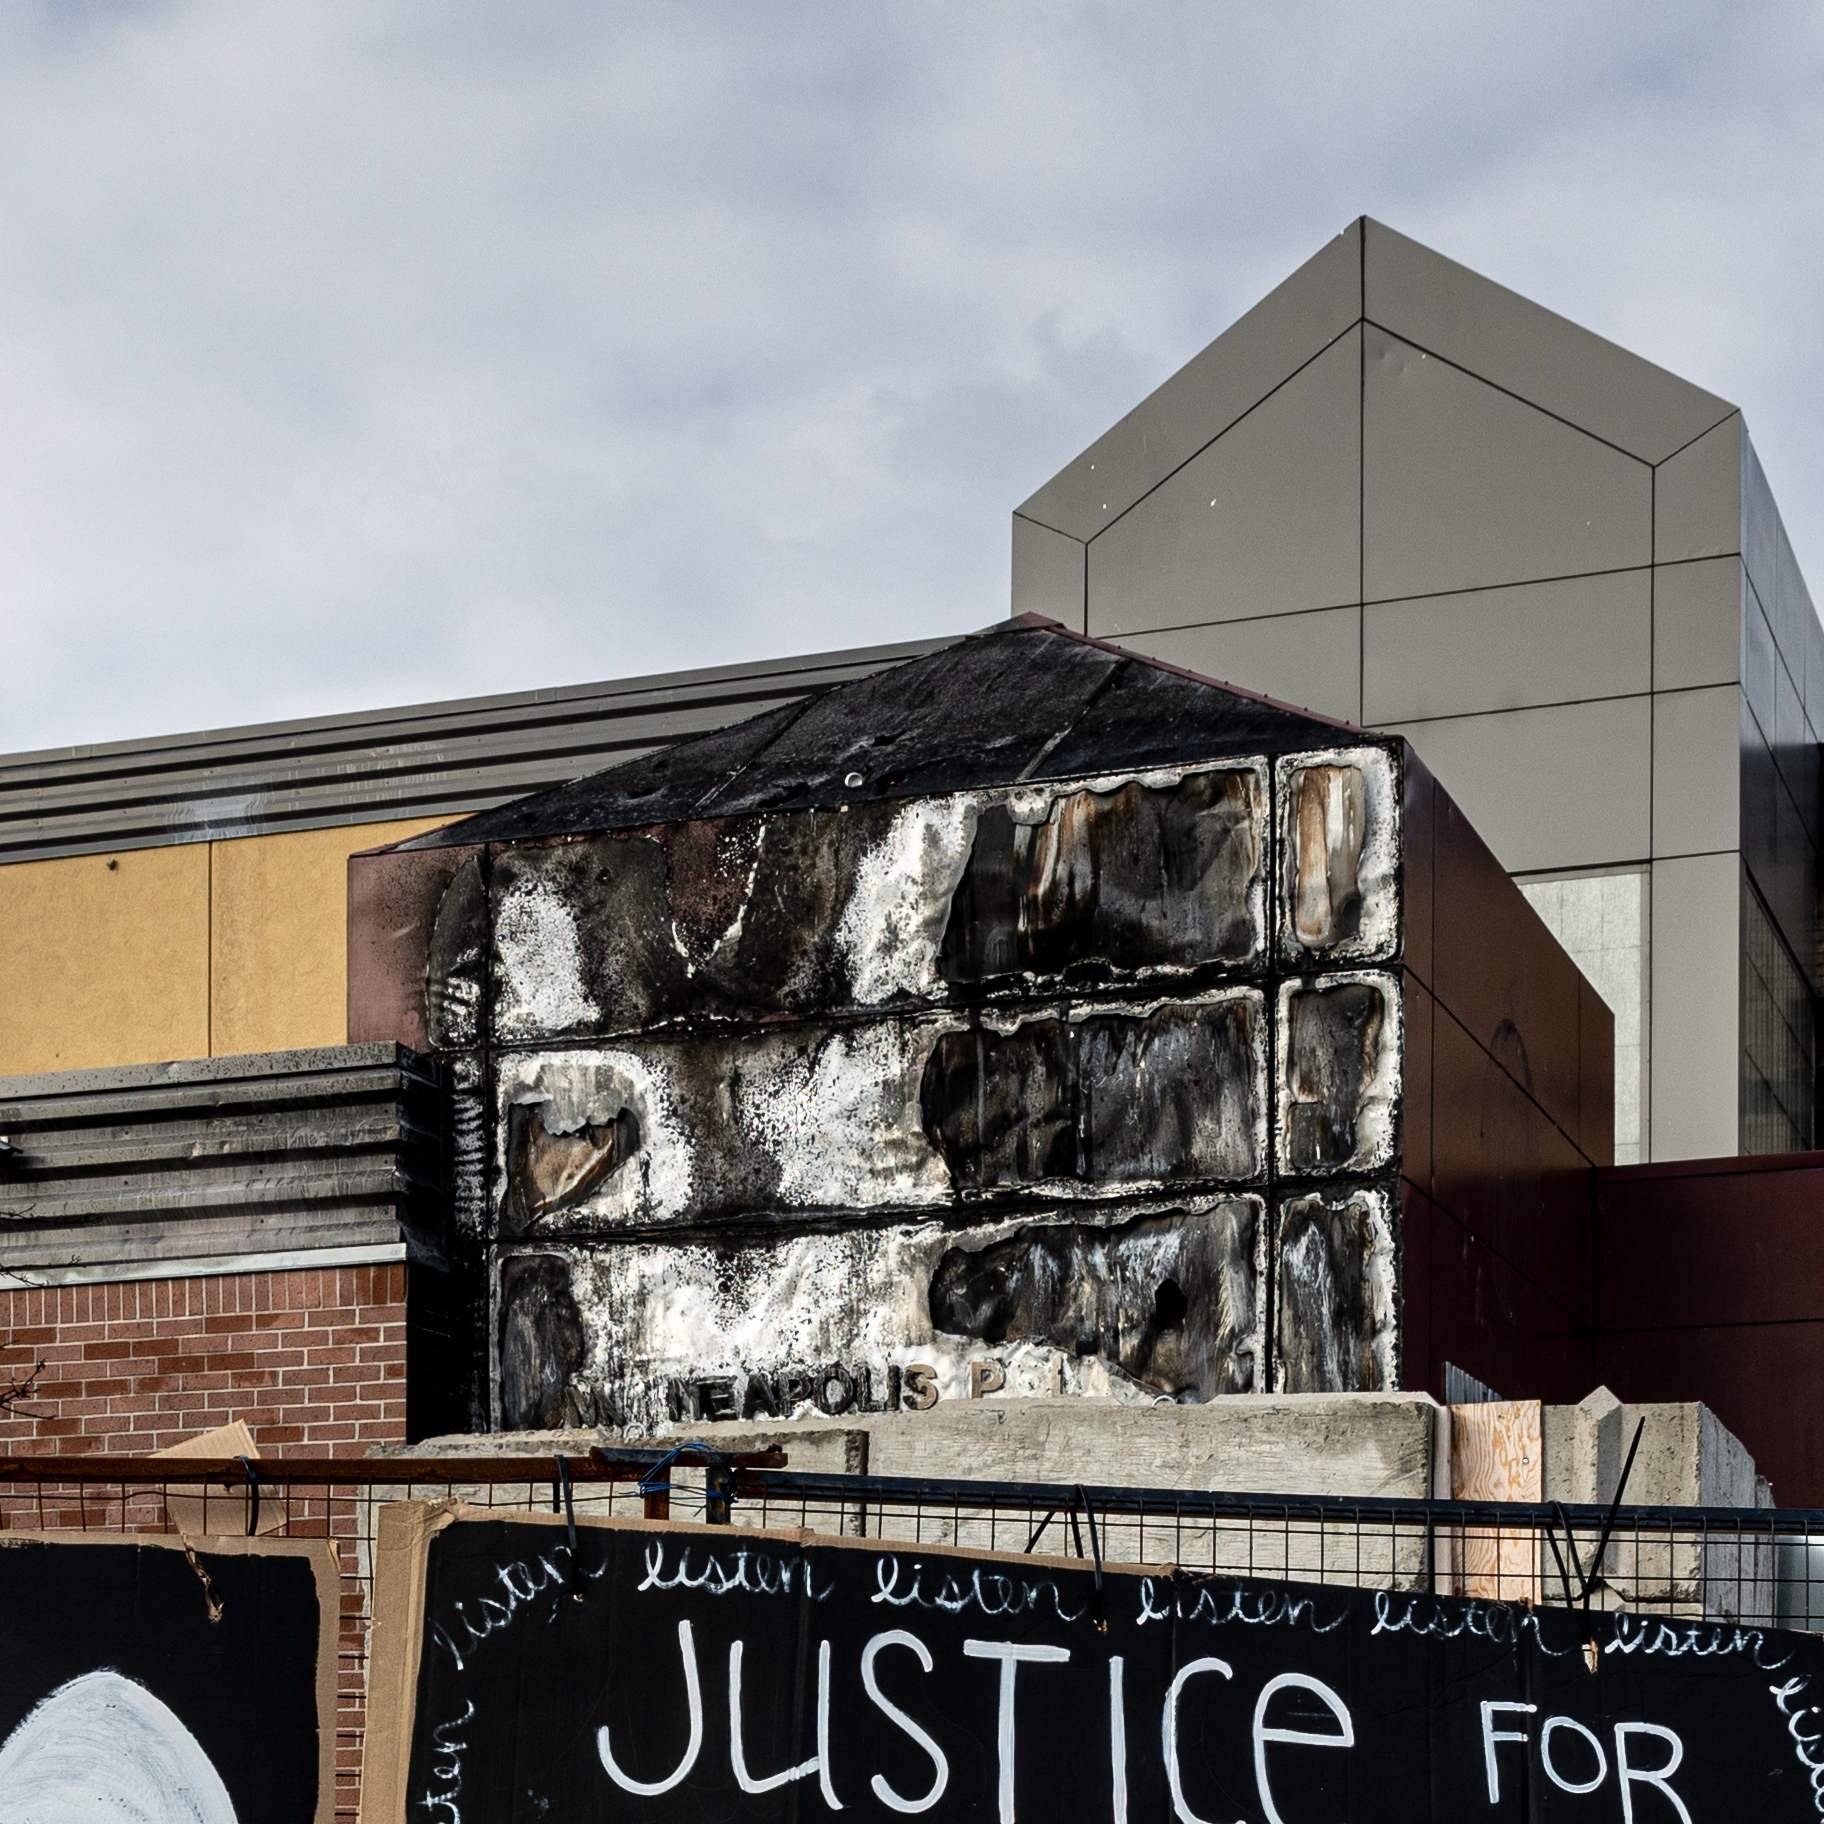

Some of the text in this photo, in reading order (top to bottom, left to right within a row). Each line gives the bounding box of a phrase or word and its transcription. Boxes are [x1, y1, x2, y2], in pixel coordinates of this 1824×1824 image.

[638, 1539, 836, 1599] listen
[871, 1554, 1085, 1622] listen
[1136, 1576, 1349, 1634] listen
[1605, 1610, 1794, 1669] listen
